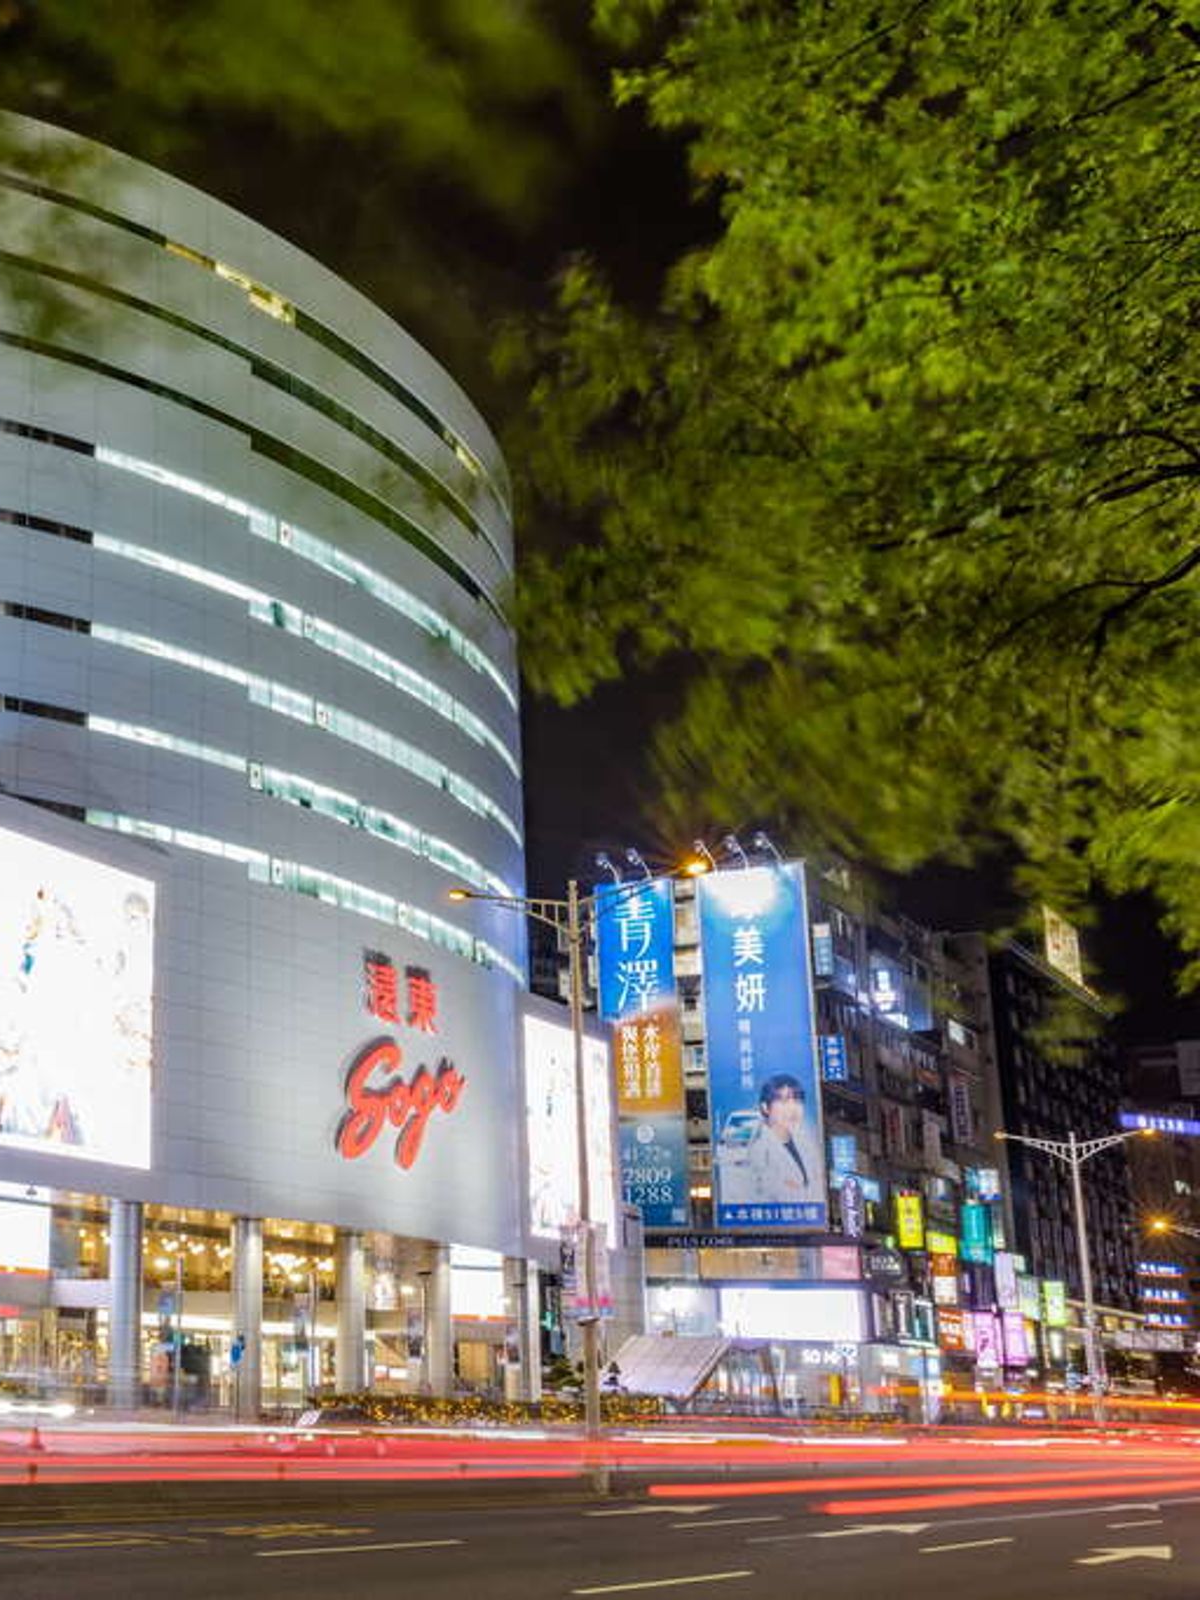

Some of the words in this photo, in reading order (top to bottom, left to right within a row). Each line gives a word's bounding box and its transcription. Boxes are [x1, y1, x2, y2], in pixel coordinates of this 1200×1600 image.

[364, 950, 440, 1033] 遠東
[623, 1169, 672, 1184] 2809
[626, 1186, 673, 1206] 1288
